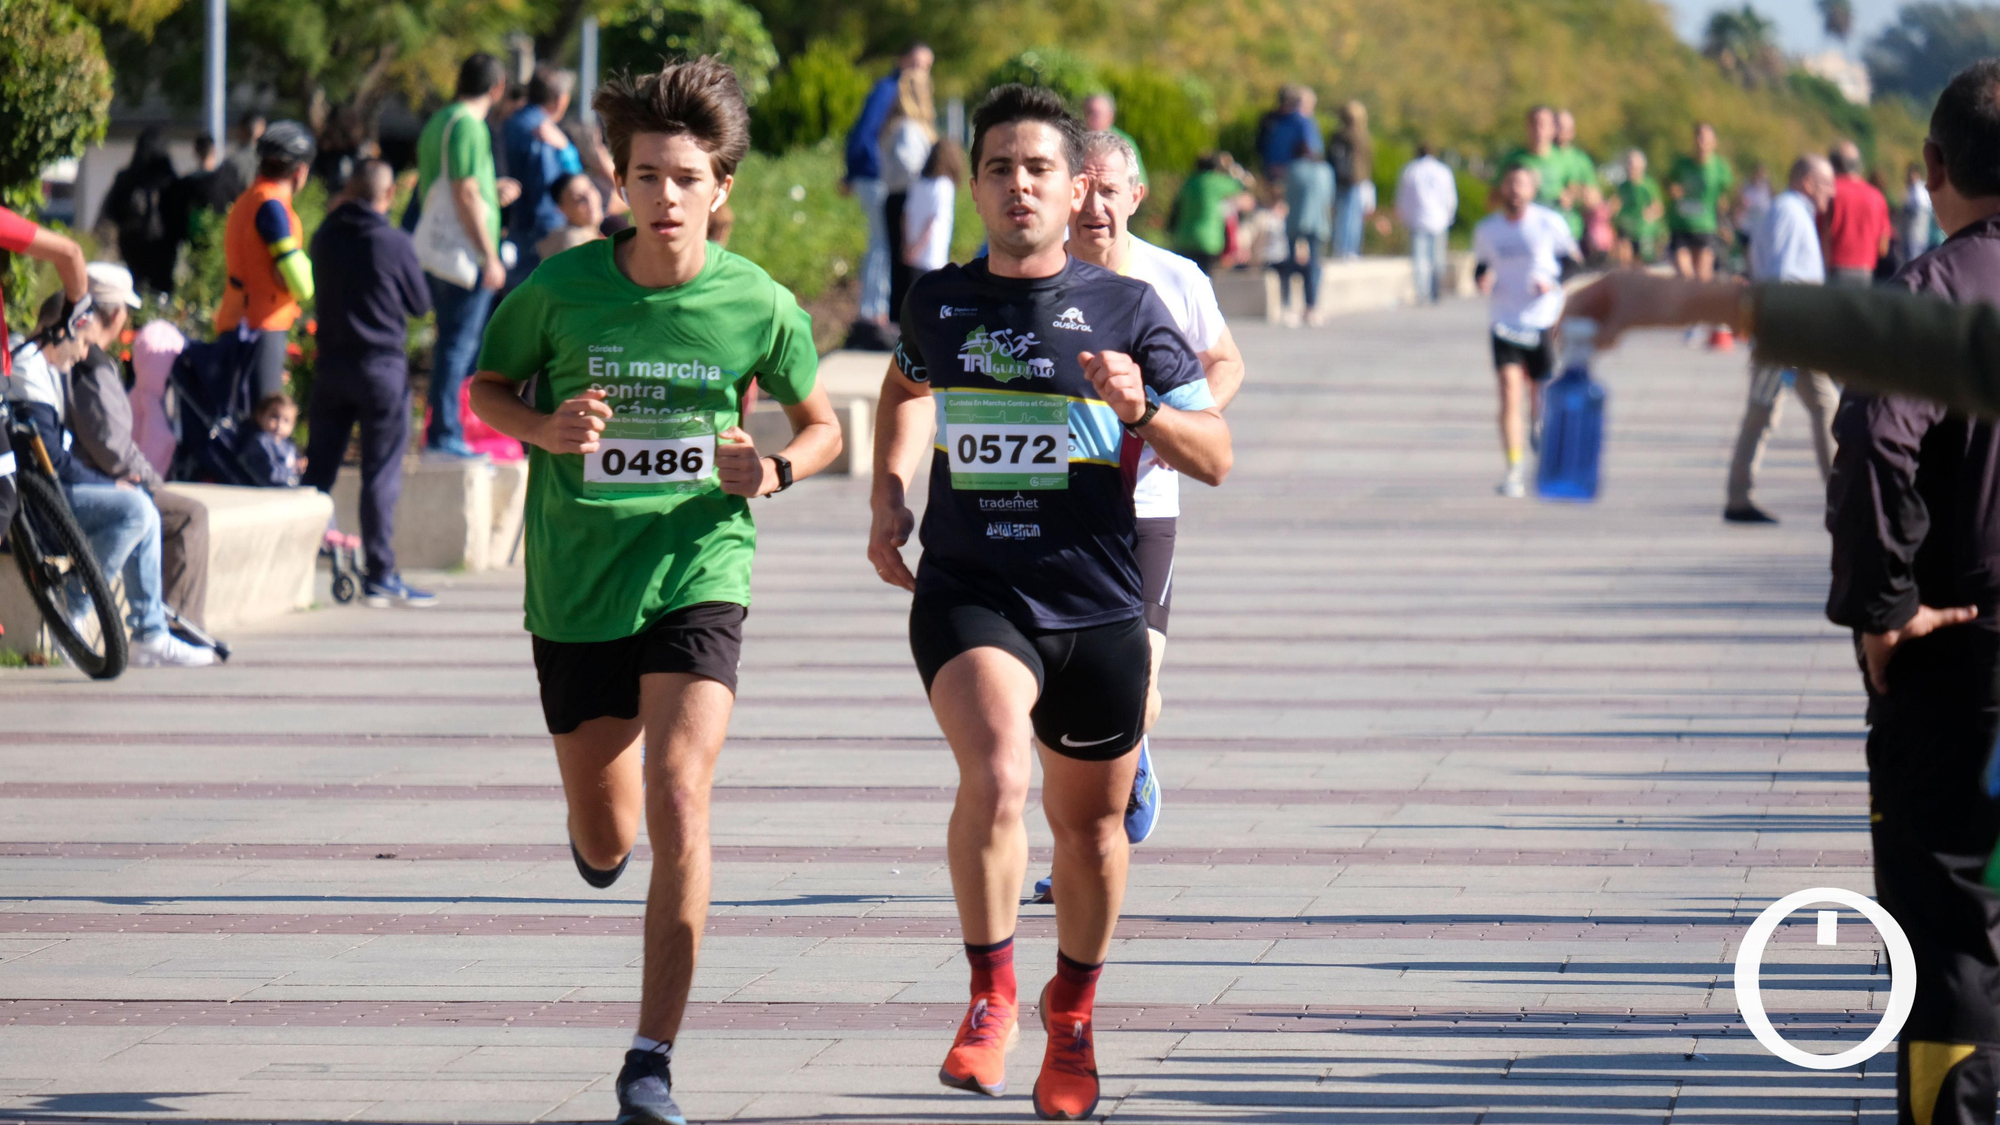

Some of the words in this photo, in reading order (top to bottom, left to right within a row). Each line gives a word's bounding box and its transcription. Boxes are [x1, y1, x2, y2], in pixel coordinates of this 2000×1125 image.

[588, 356, 620, 377] En
[628, 360, 721, 380] marcha
[602, 447, 704, 476] 0486
[957, 434, 1057, 464] 0572
[979, 497, 1039, 508] trademet
